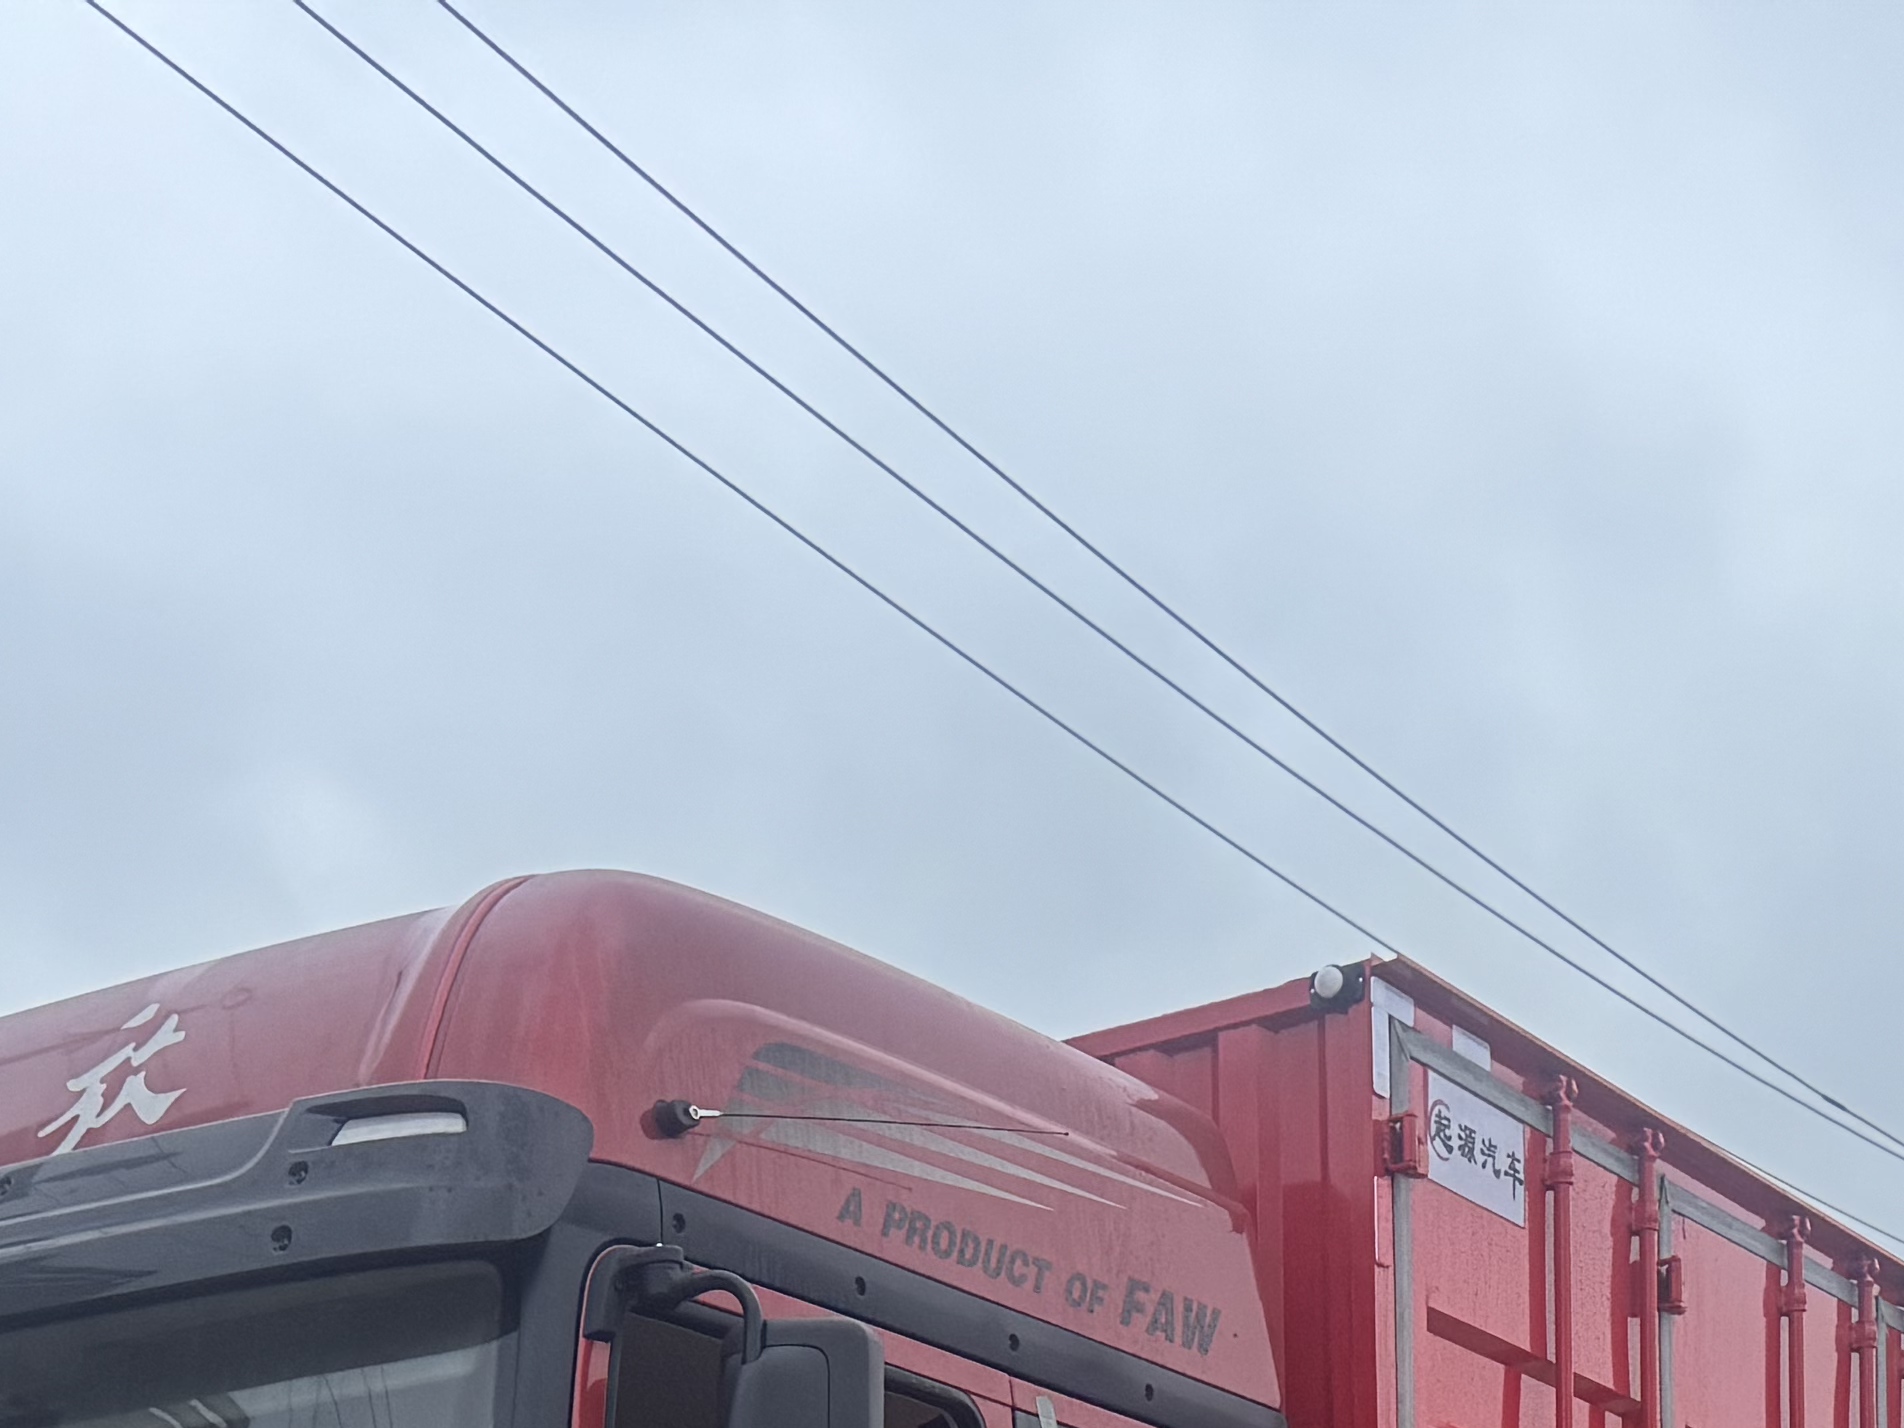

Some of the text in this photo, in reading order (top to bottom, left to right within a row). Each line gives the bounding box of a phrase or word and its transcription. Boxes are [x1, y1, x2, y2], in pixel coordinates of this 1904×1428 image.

[1432, 1108, 1524, 1201] 起源汽车
[836, 1187, 1223, 1357] A PRODUCT OF FAW
